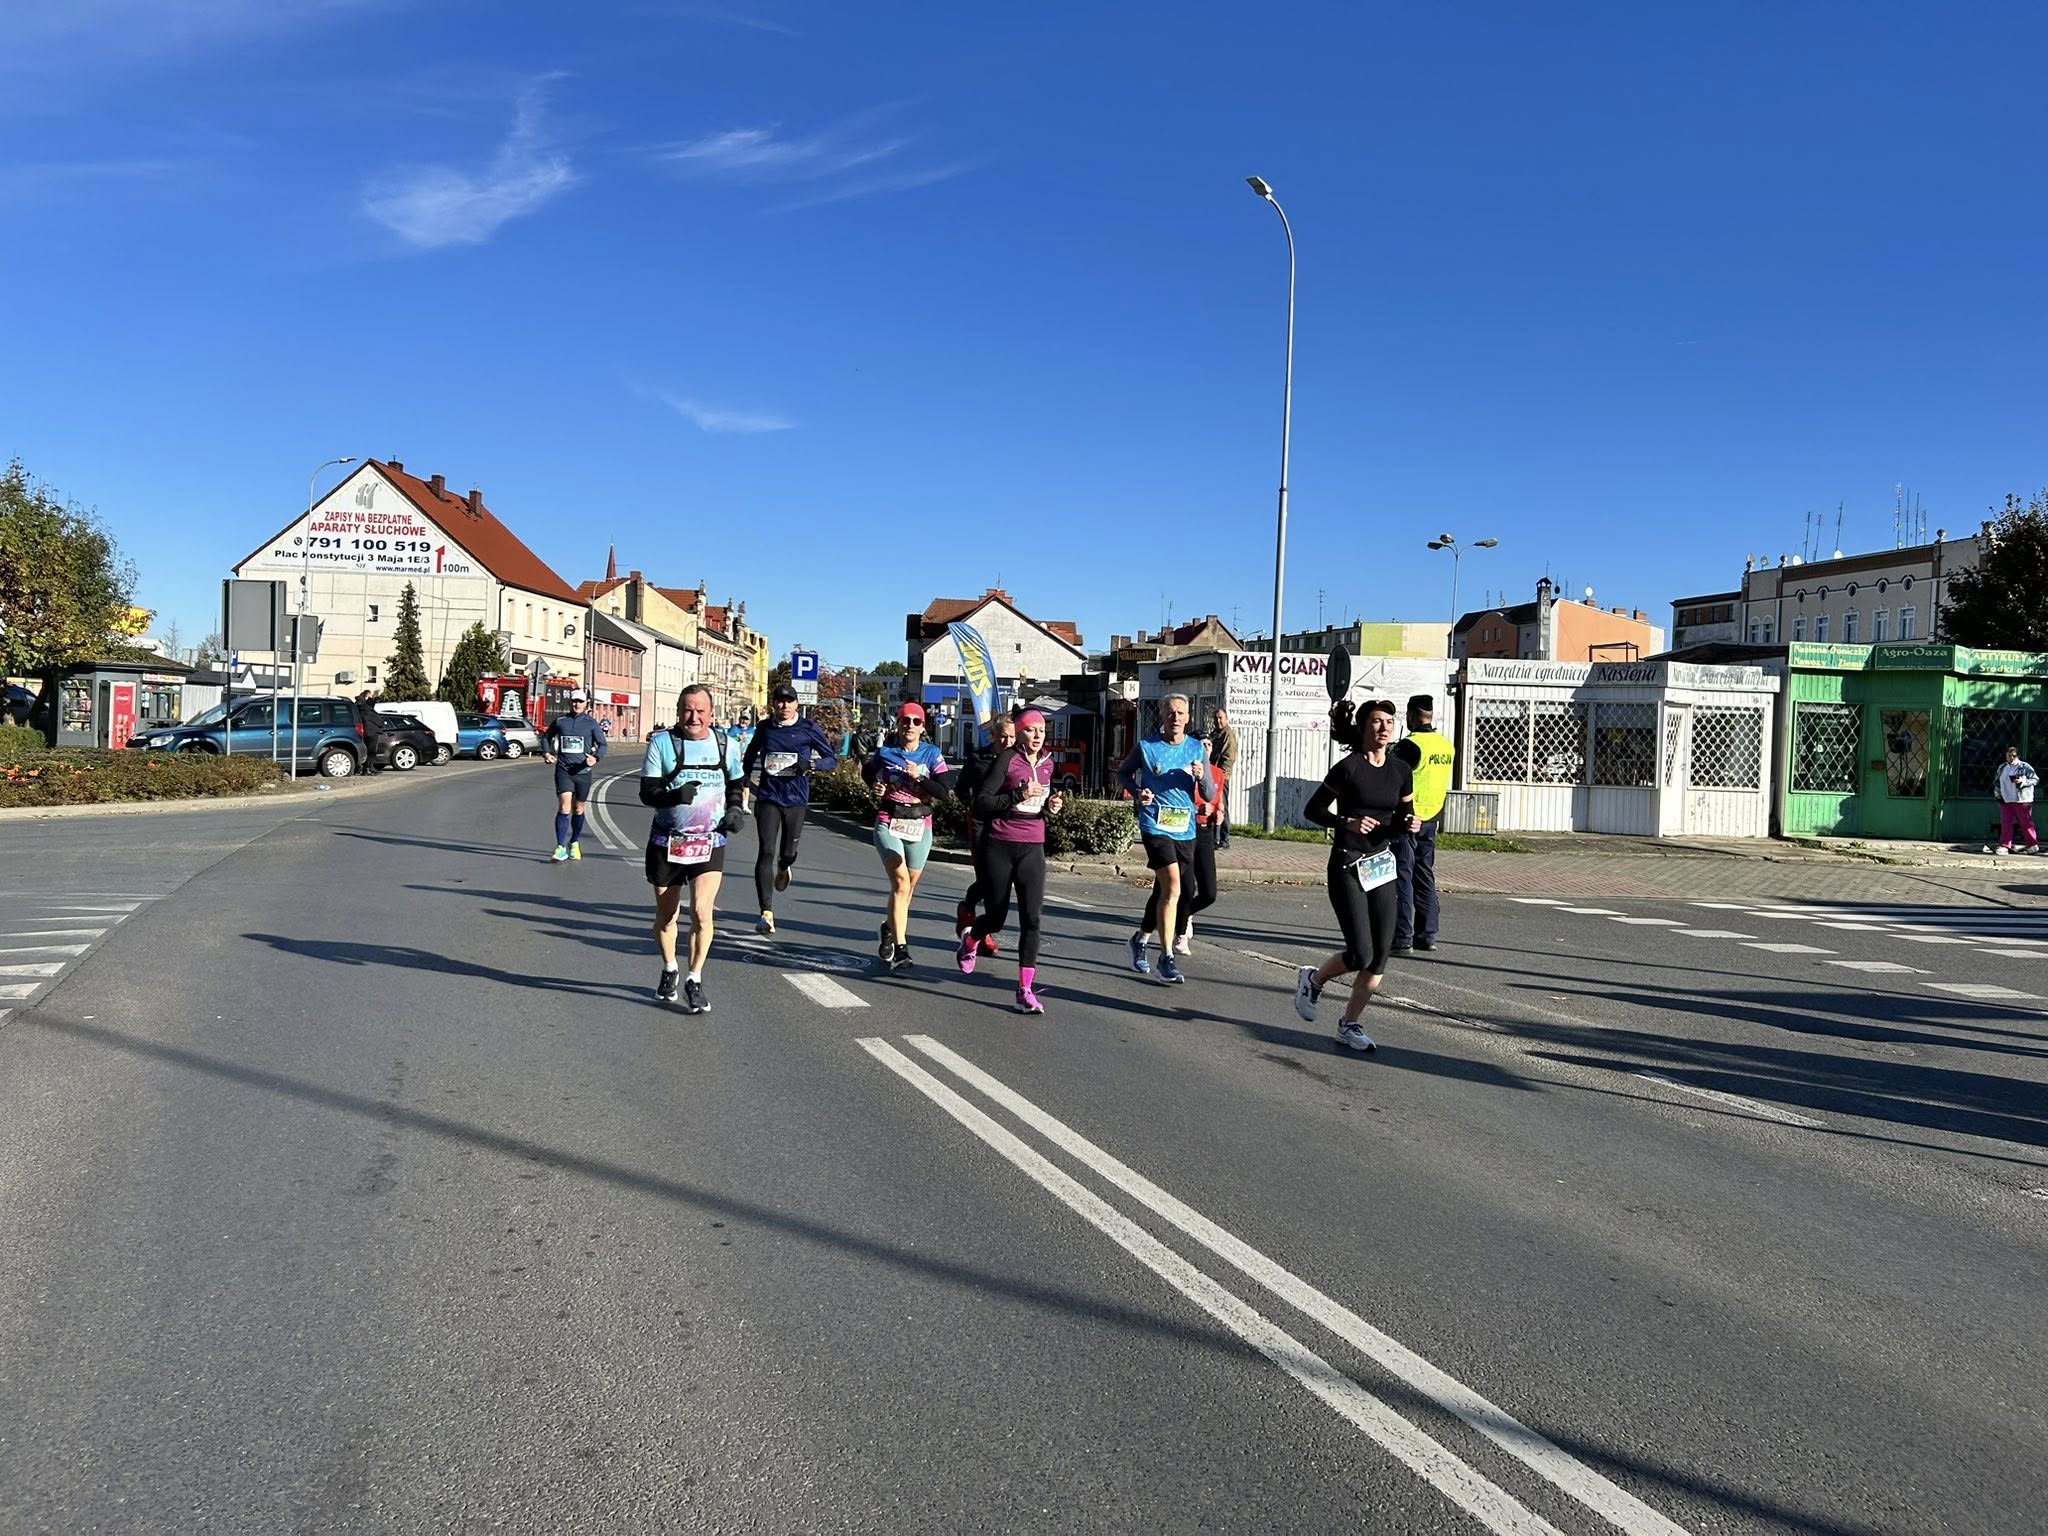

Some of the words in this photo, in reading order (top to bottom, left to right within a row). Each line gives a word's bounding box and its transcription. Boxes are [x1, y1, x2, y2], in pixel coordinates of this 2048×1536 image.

[325, 511, 352, 522] ZAPISY
[355, 512, 366, 522] NA
[368, 513, 412, 525] BEZPŁATNE
[310, 522, 360, 533] APARATY
[364, 524, 426, 536] SŁUCHOWE
[309, 537, 341, 549] 791
[351, 538, 387, 550] 100
[394, 541, 431, 553] 519
[275, 550, 298, 559] Plac
[302, 551, 364, 562] Konstytucji
[367, 553, 374, 561] 3
[377, 554, 404, 565] Maja
[407, 556, 431, 564] 1E/3
[376, 565, 430, 574] www.marmed.pl
[443, 564, 469, 573] 100m
[1881, 647, 1948, 659] Agro-Oaza
[2028, 654, 2048, 664] OG
[798, 655, 813, 676] P
[1233, 655, 1328, 675] KWICIARN
[1243, 674, 1259, 684] 515
[685, 844, 710, 857] 678
[1374, 861, 1394, 878] 172
